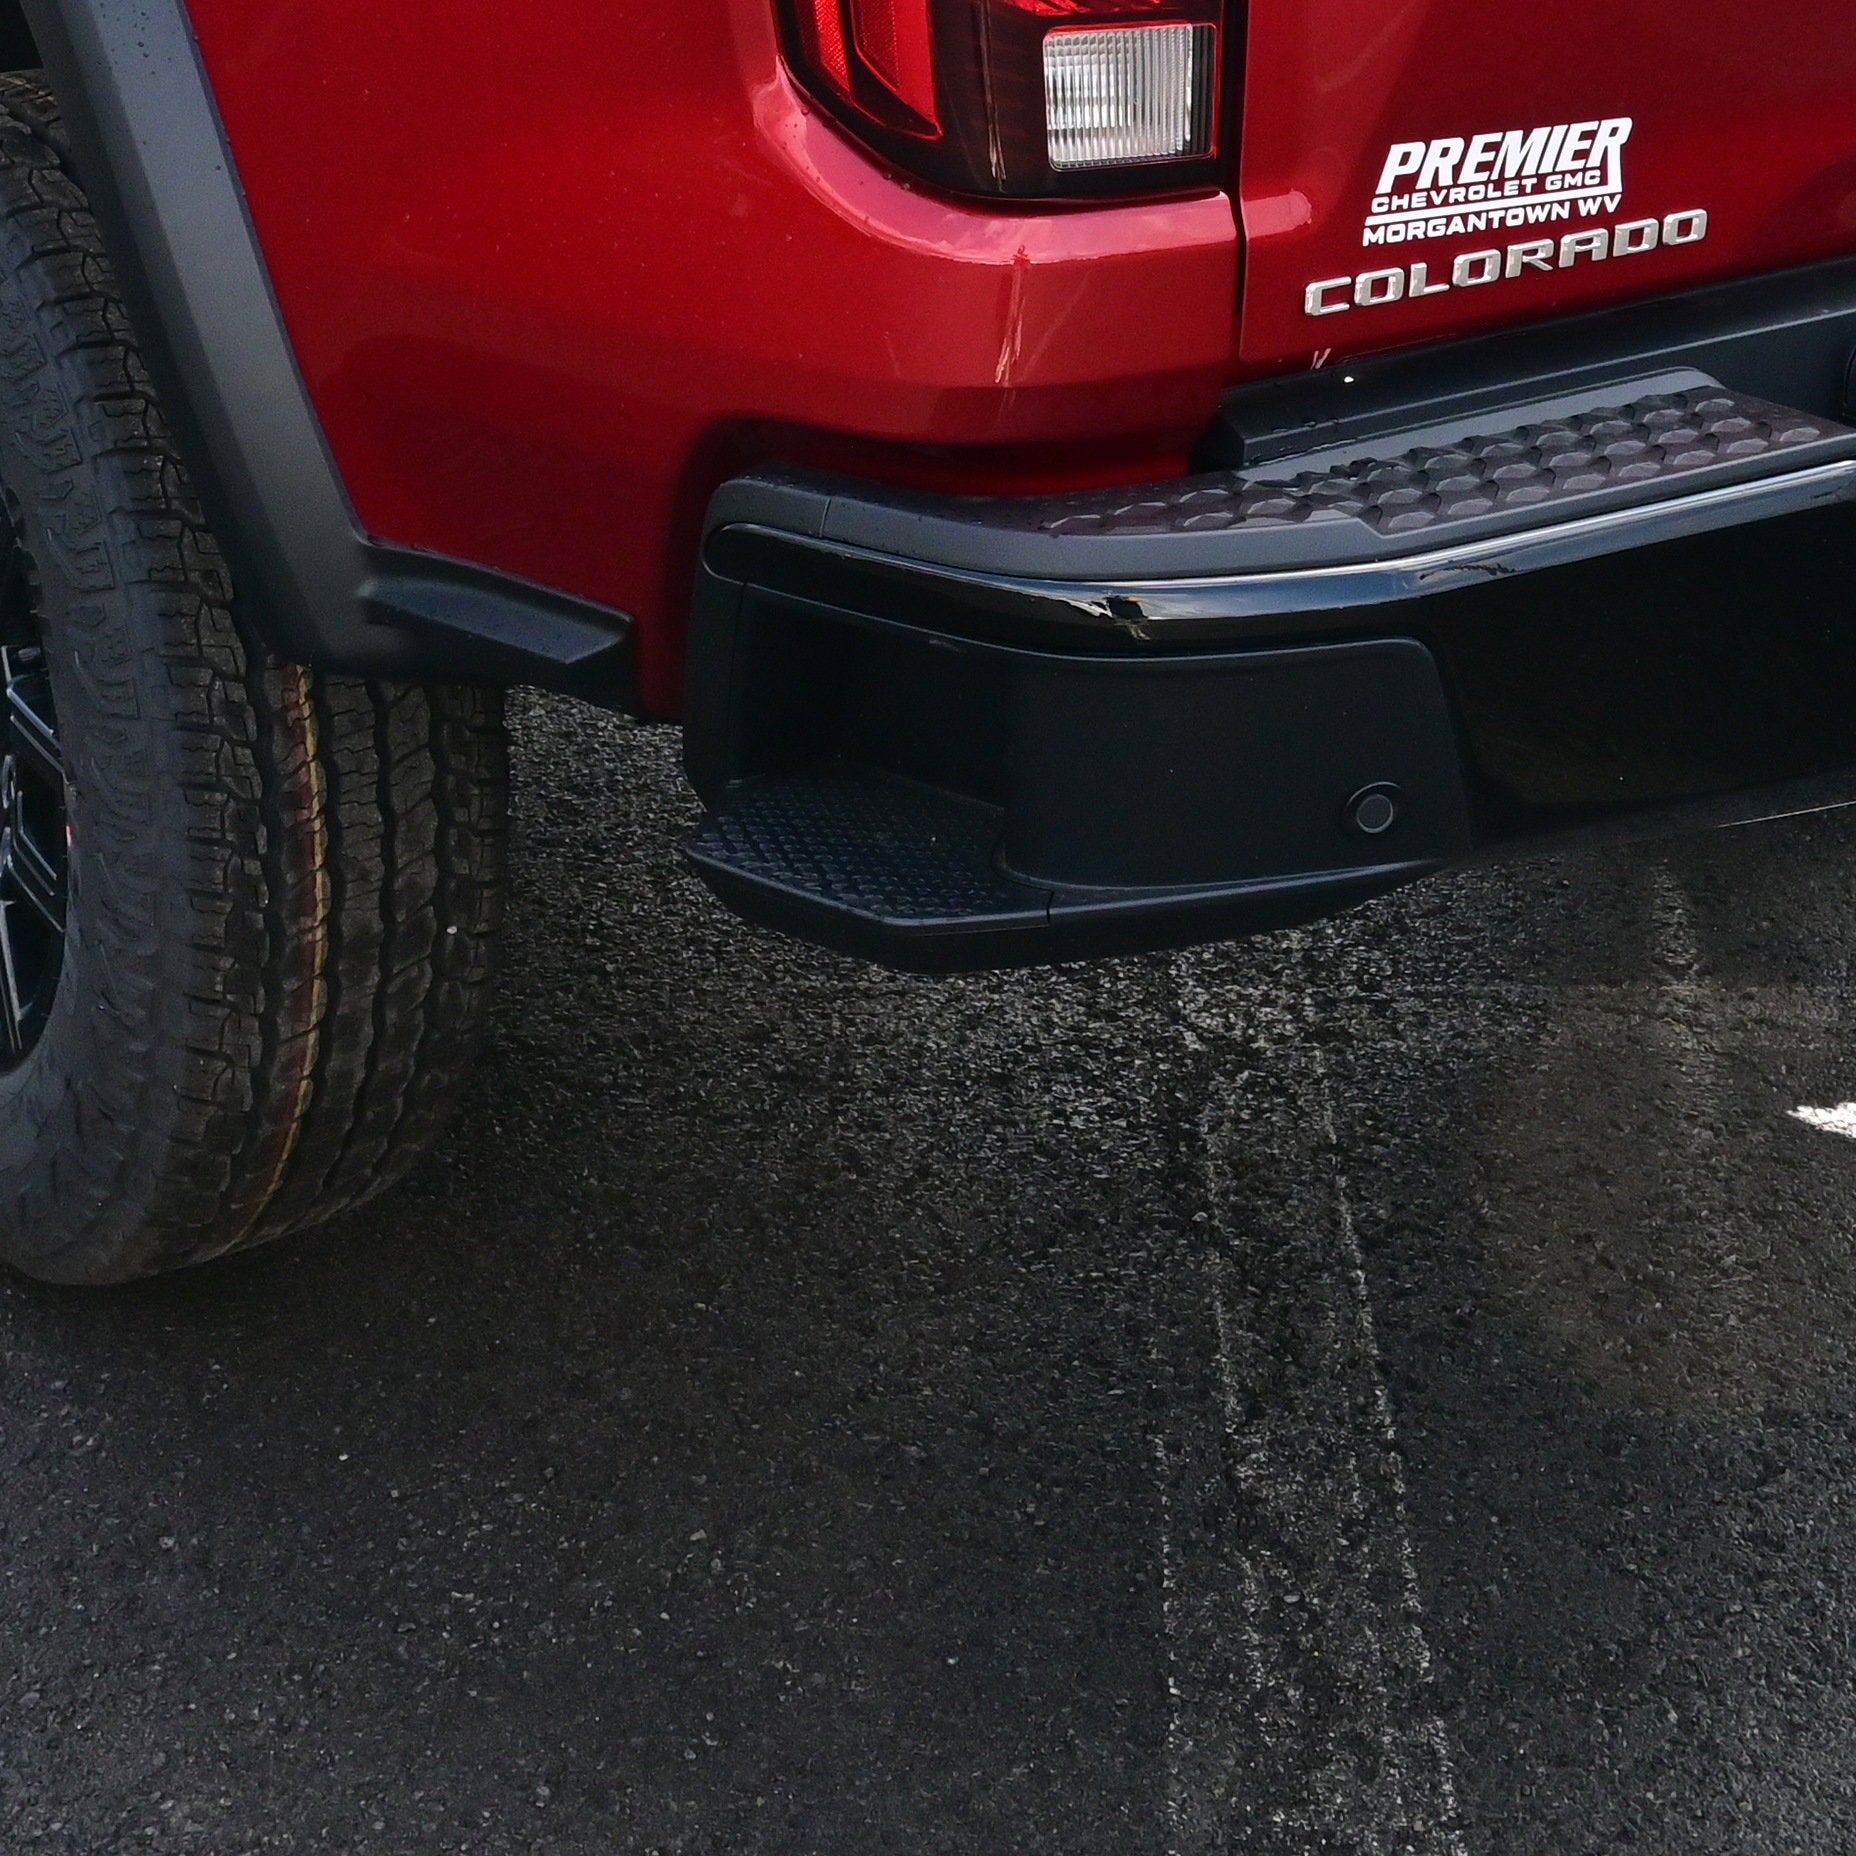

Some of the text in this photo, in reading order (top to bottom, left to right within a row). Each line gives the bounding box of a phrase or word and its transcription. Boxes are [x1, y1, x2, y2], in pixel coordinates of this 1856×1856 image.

[1376, 117, 1633, 194] PREMIER
[1362, 193, 1623, 247] MORGANTOWN WV
[1371, 168, 1602, 213] CHEVROLET GMC
[1304, 208, 1708, 317] COLORADO
